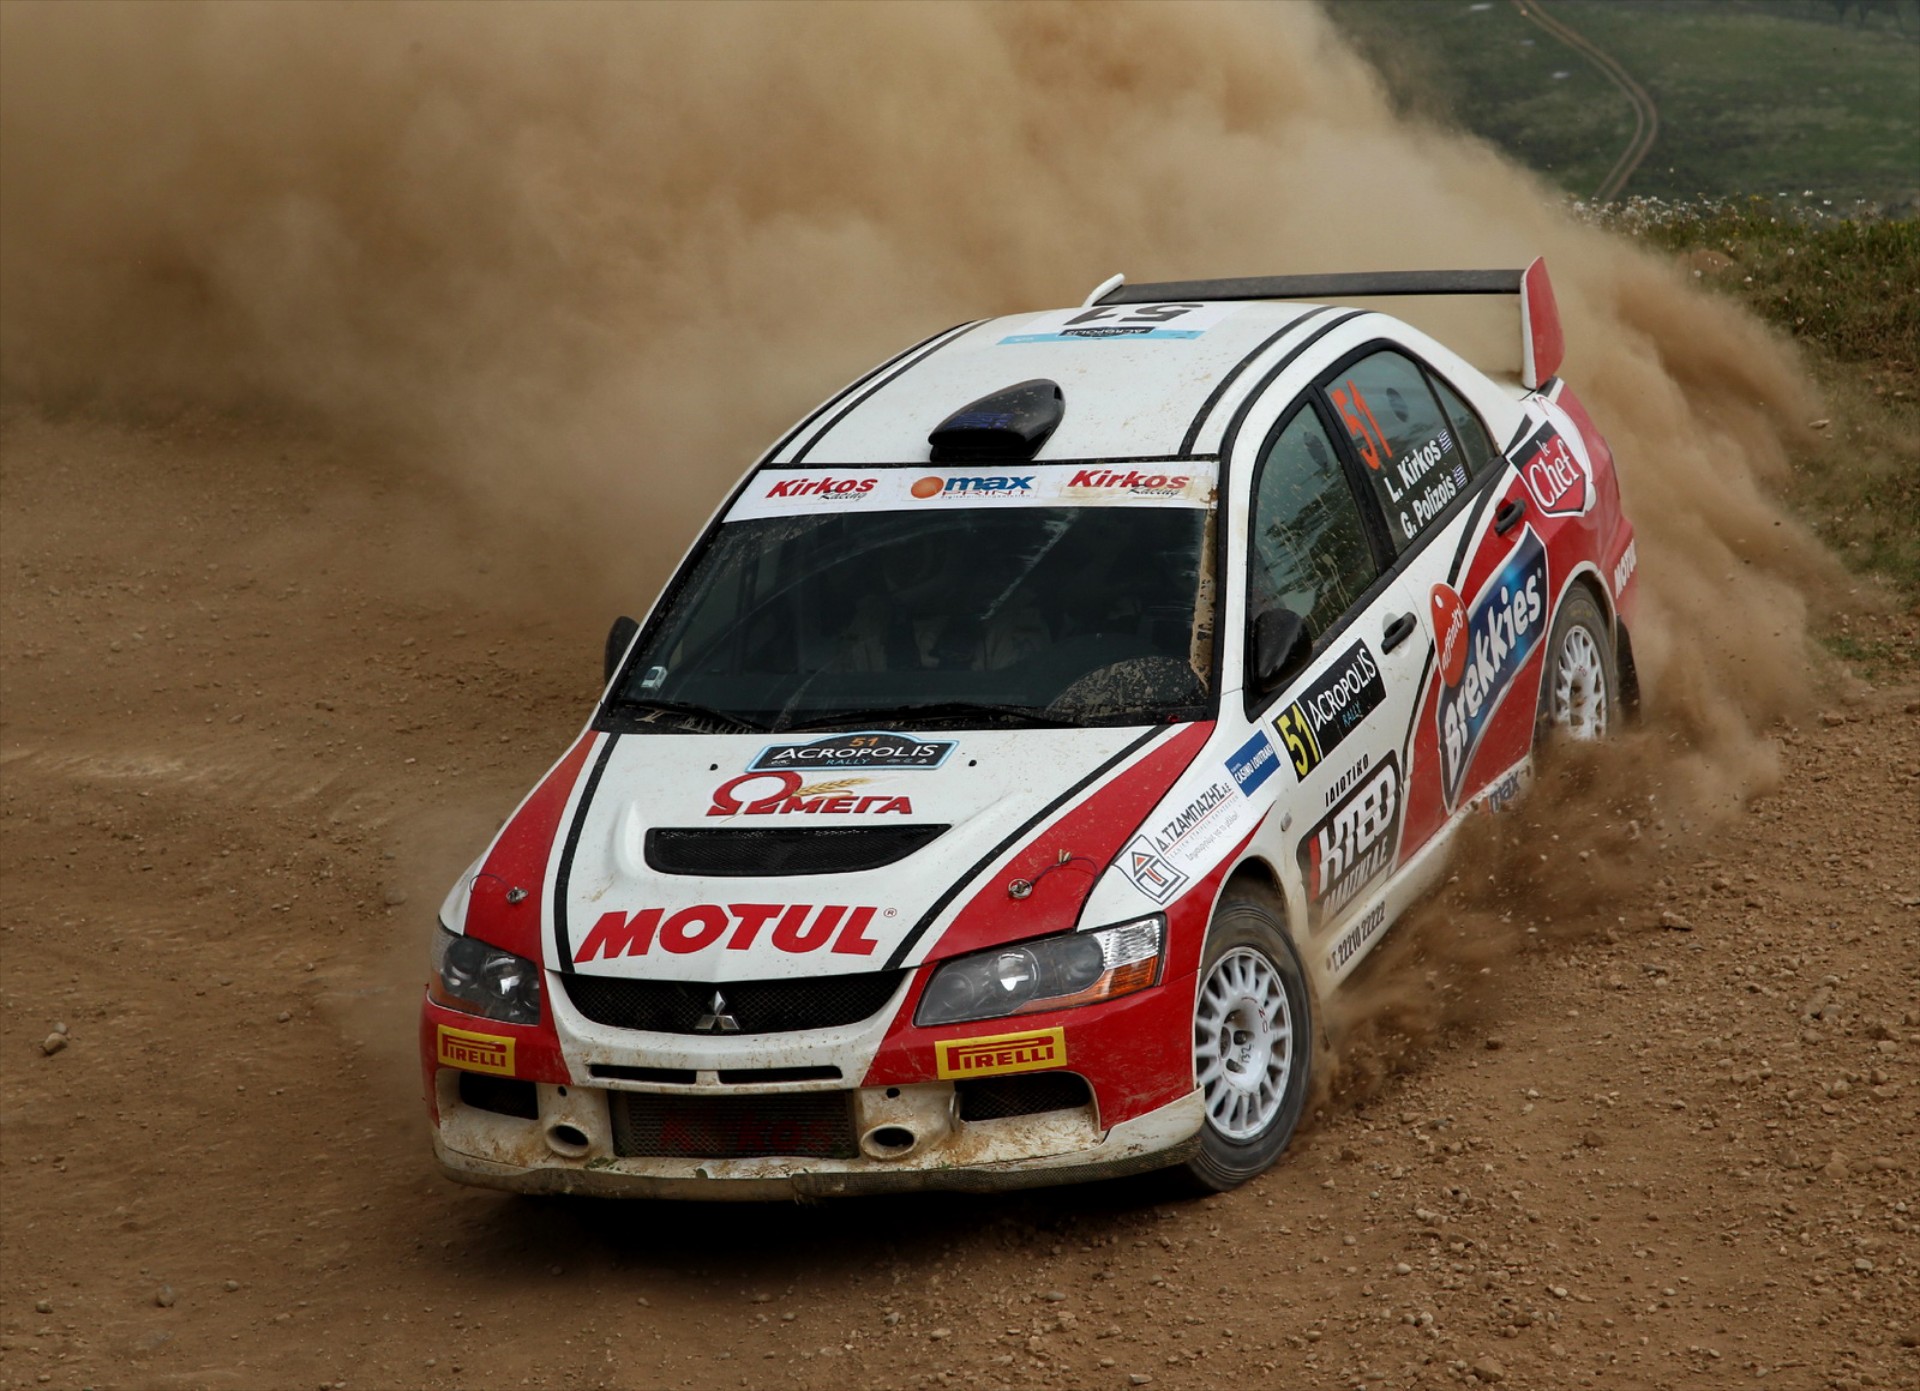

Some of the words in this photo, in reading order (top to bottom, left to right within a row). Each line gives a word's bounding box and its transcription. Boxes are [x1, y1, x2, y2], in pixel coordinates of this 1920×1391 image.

[1063, 304, 1204, 326] 51
[1331, 379, 1393, 470] 51
[765, 477, 878, 498] Kirkos
[945, 476, 1036, 491] max
[1067, 470, 1190, 489] Kirkos
[1384, 477, 1403, 503] L.
[1397, 439, 1442, 491] Kirkos
[1529, 438, 1579, 507] Chef
[1400, 512, 1417, 539] G.
[1307, 647, 1377, 732] ACROPOLIS
[1443, 580, 1541, 793] Brekkies
[773, 744, 939, 759] ACROPOLIS
[849, 737, 880, 747] 51
[1277, 703, 1320, 776] 51
[573, 903, 879, 963] MOTUL
[442, 1034, 507, 1067] PIRELLI
[947, 1035, 1055, 1071] PIRELLI
